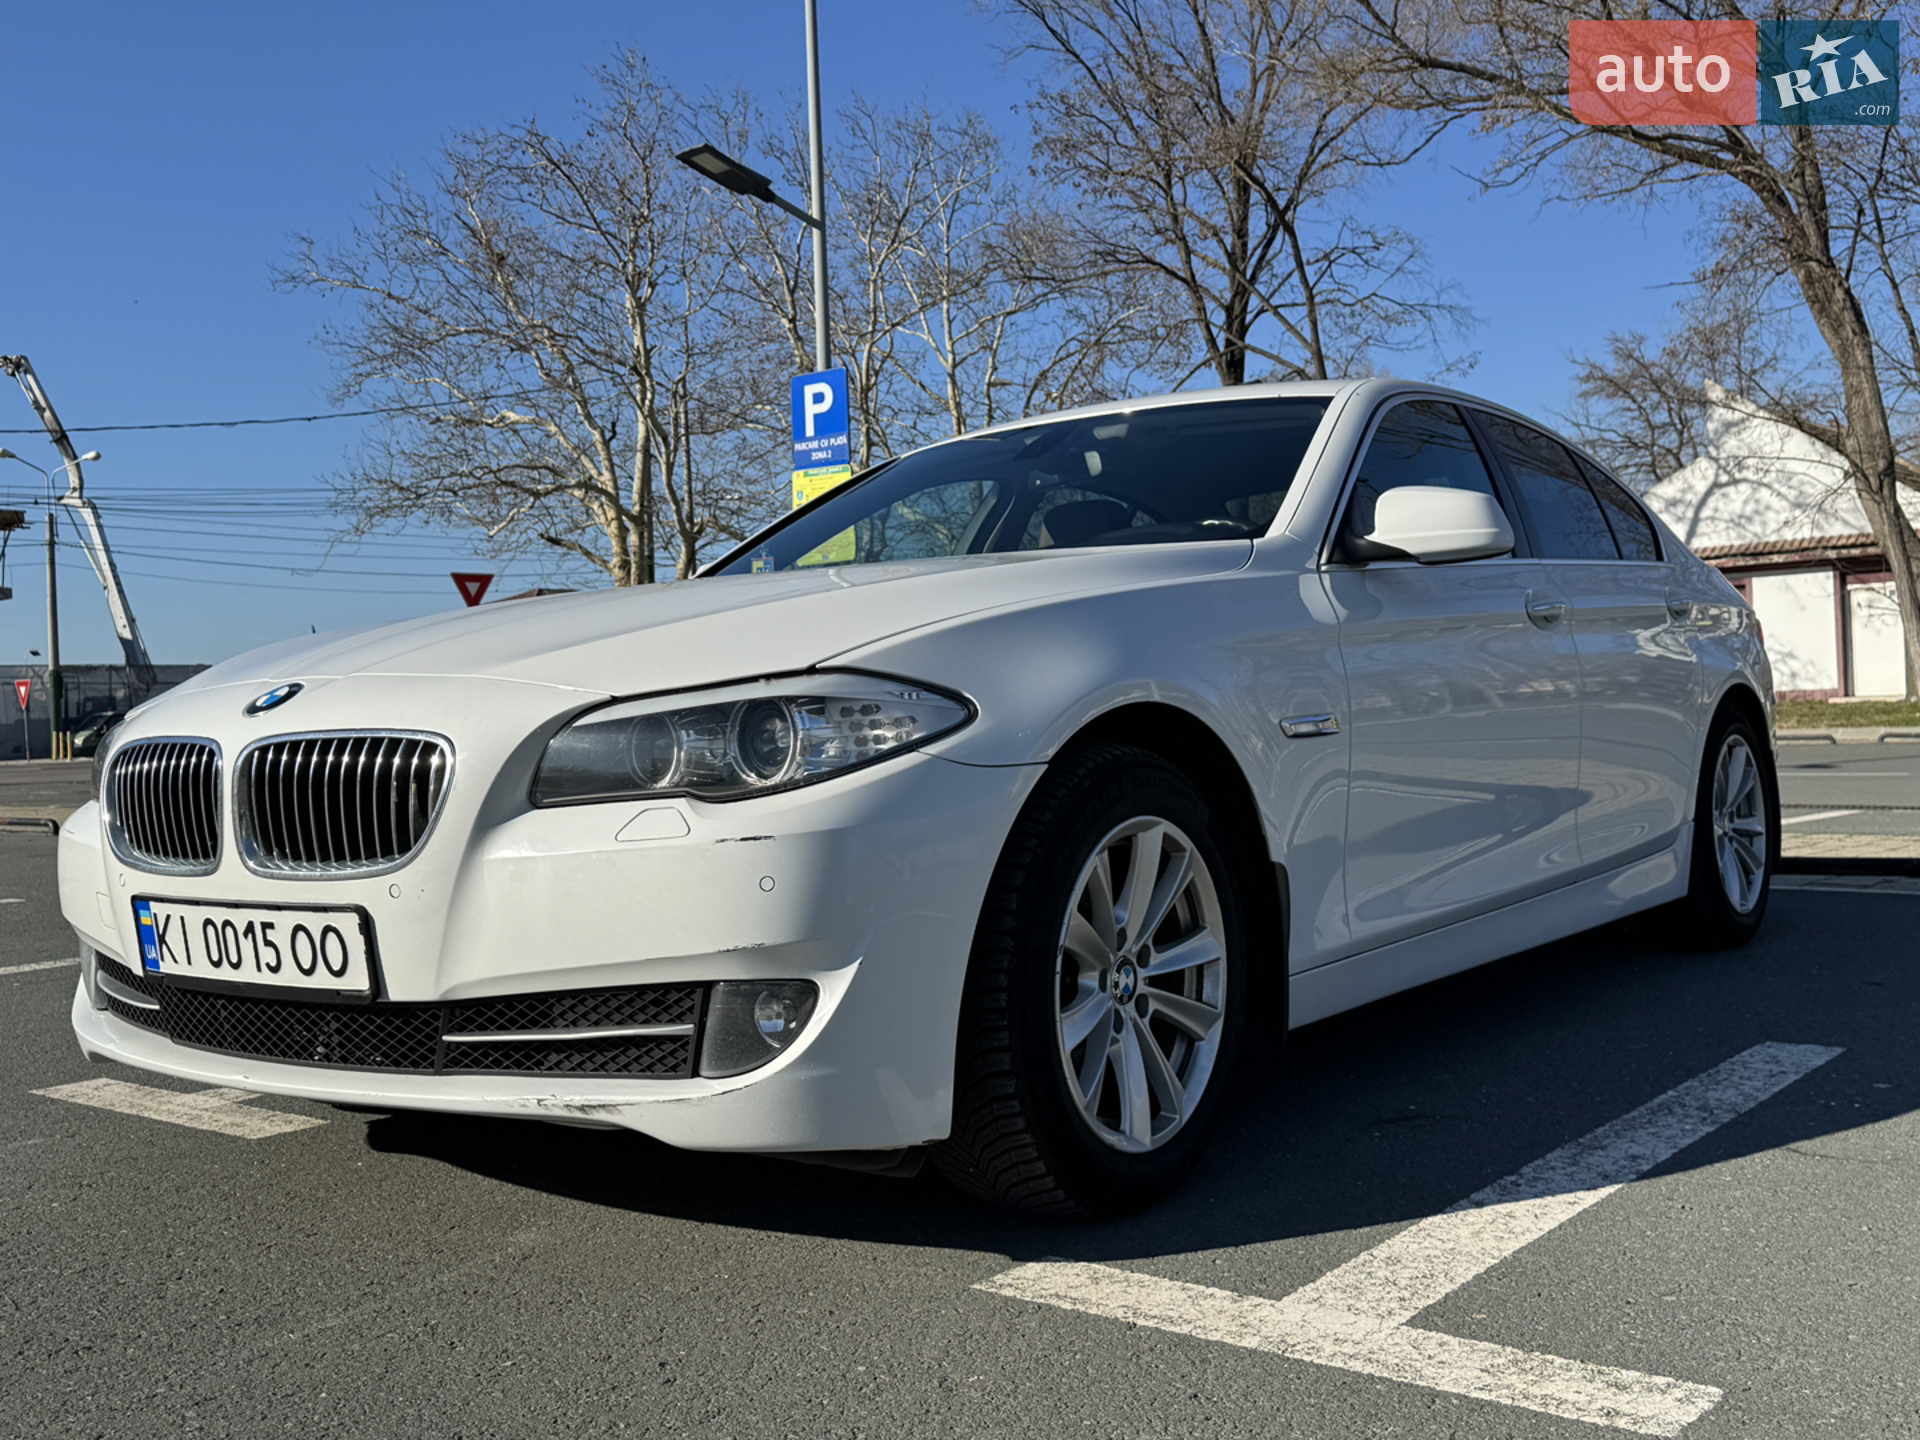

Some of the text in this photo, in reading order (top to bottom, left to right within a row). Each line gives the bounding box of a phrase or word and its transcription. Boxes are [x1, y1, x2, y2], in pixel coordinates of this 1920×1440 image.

[804, 382, 833, 438] P
[795, 440, 819, 451] PARCARE
[820, 439, 829, 448] CU
[811, 449, 832, 460] ZONA 2
[145, 944, 158, 960] UA
[153, 912, 348, 978] KI 0015 OO
